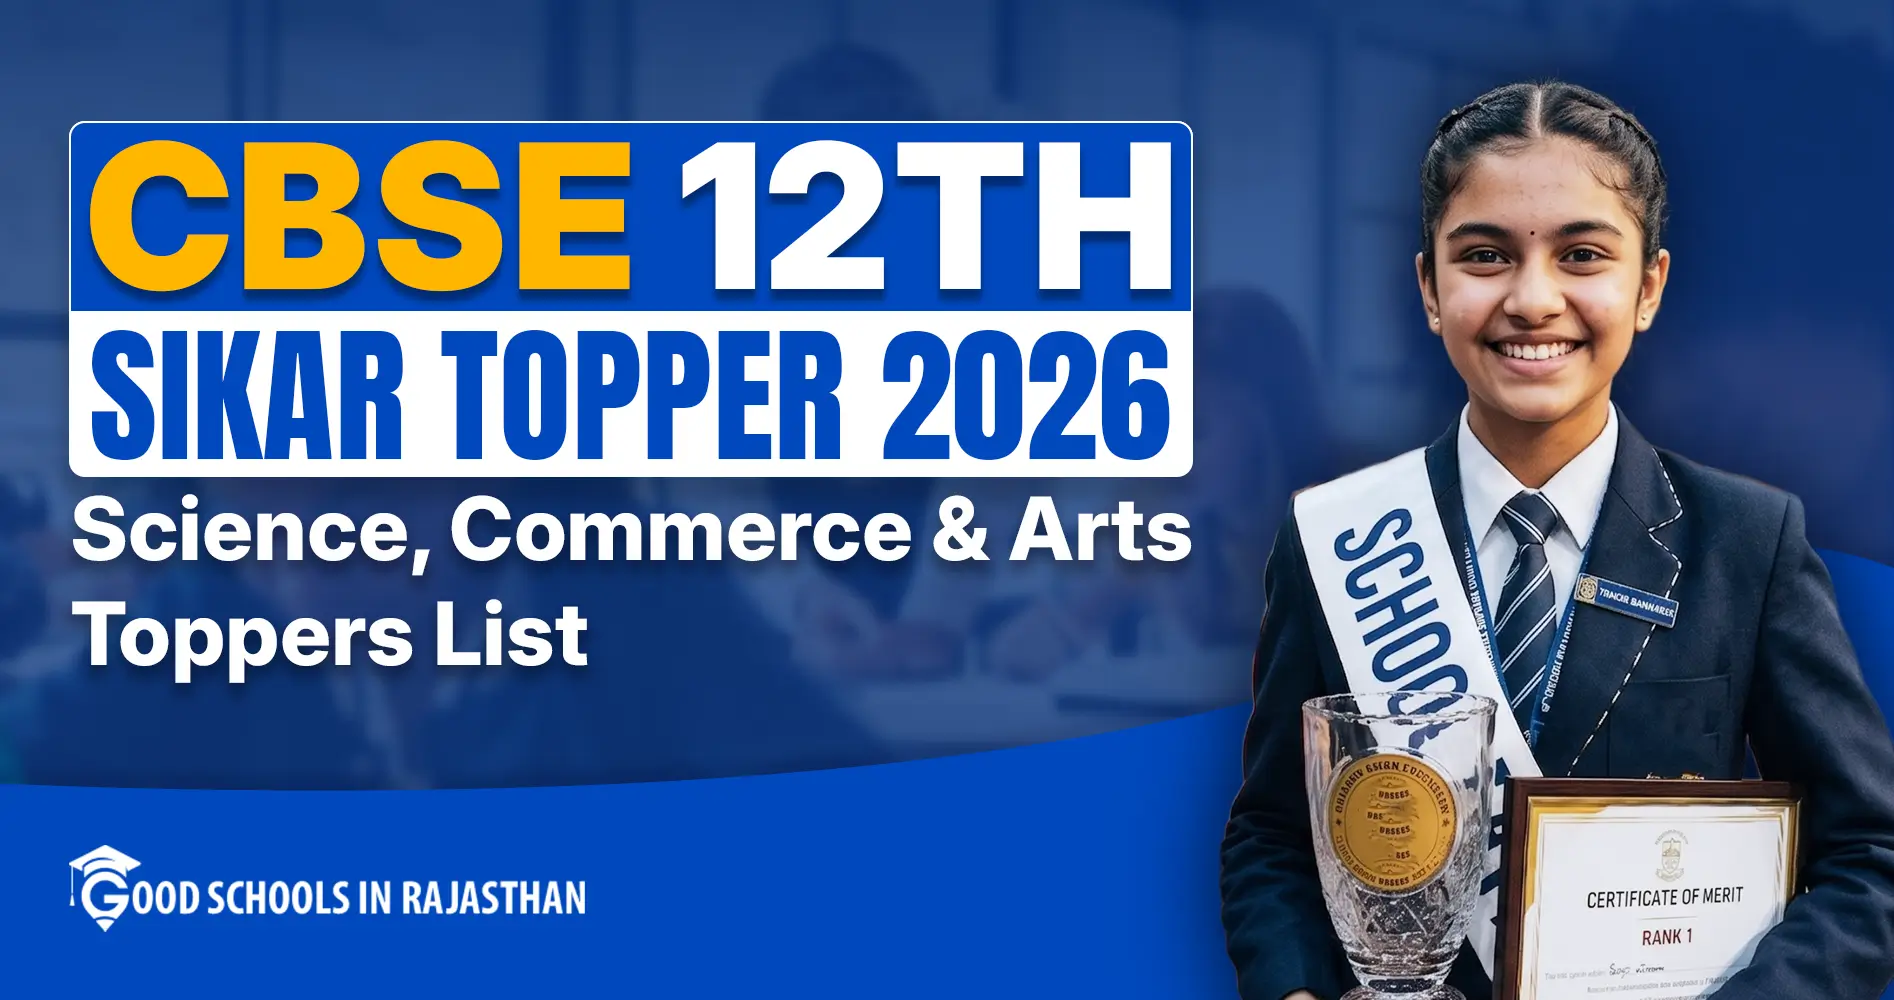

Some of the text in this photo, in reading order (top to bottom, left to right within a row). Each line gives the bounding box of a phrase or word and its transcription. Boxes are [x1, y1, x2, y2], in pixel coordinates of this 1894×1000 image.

[1587, 886, 1744, 909] CERTIFICATE OF MERIT
[1642, 928, 1693, 946] RANK 1
